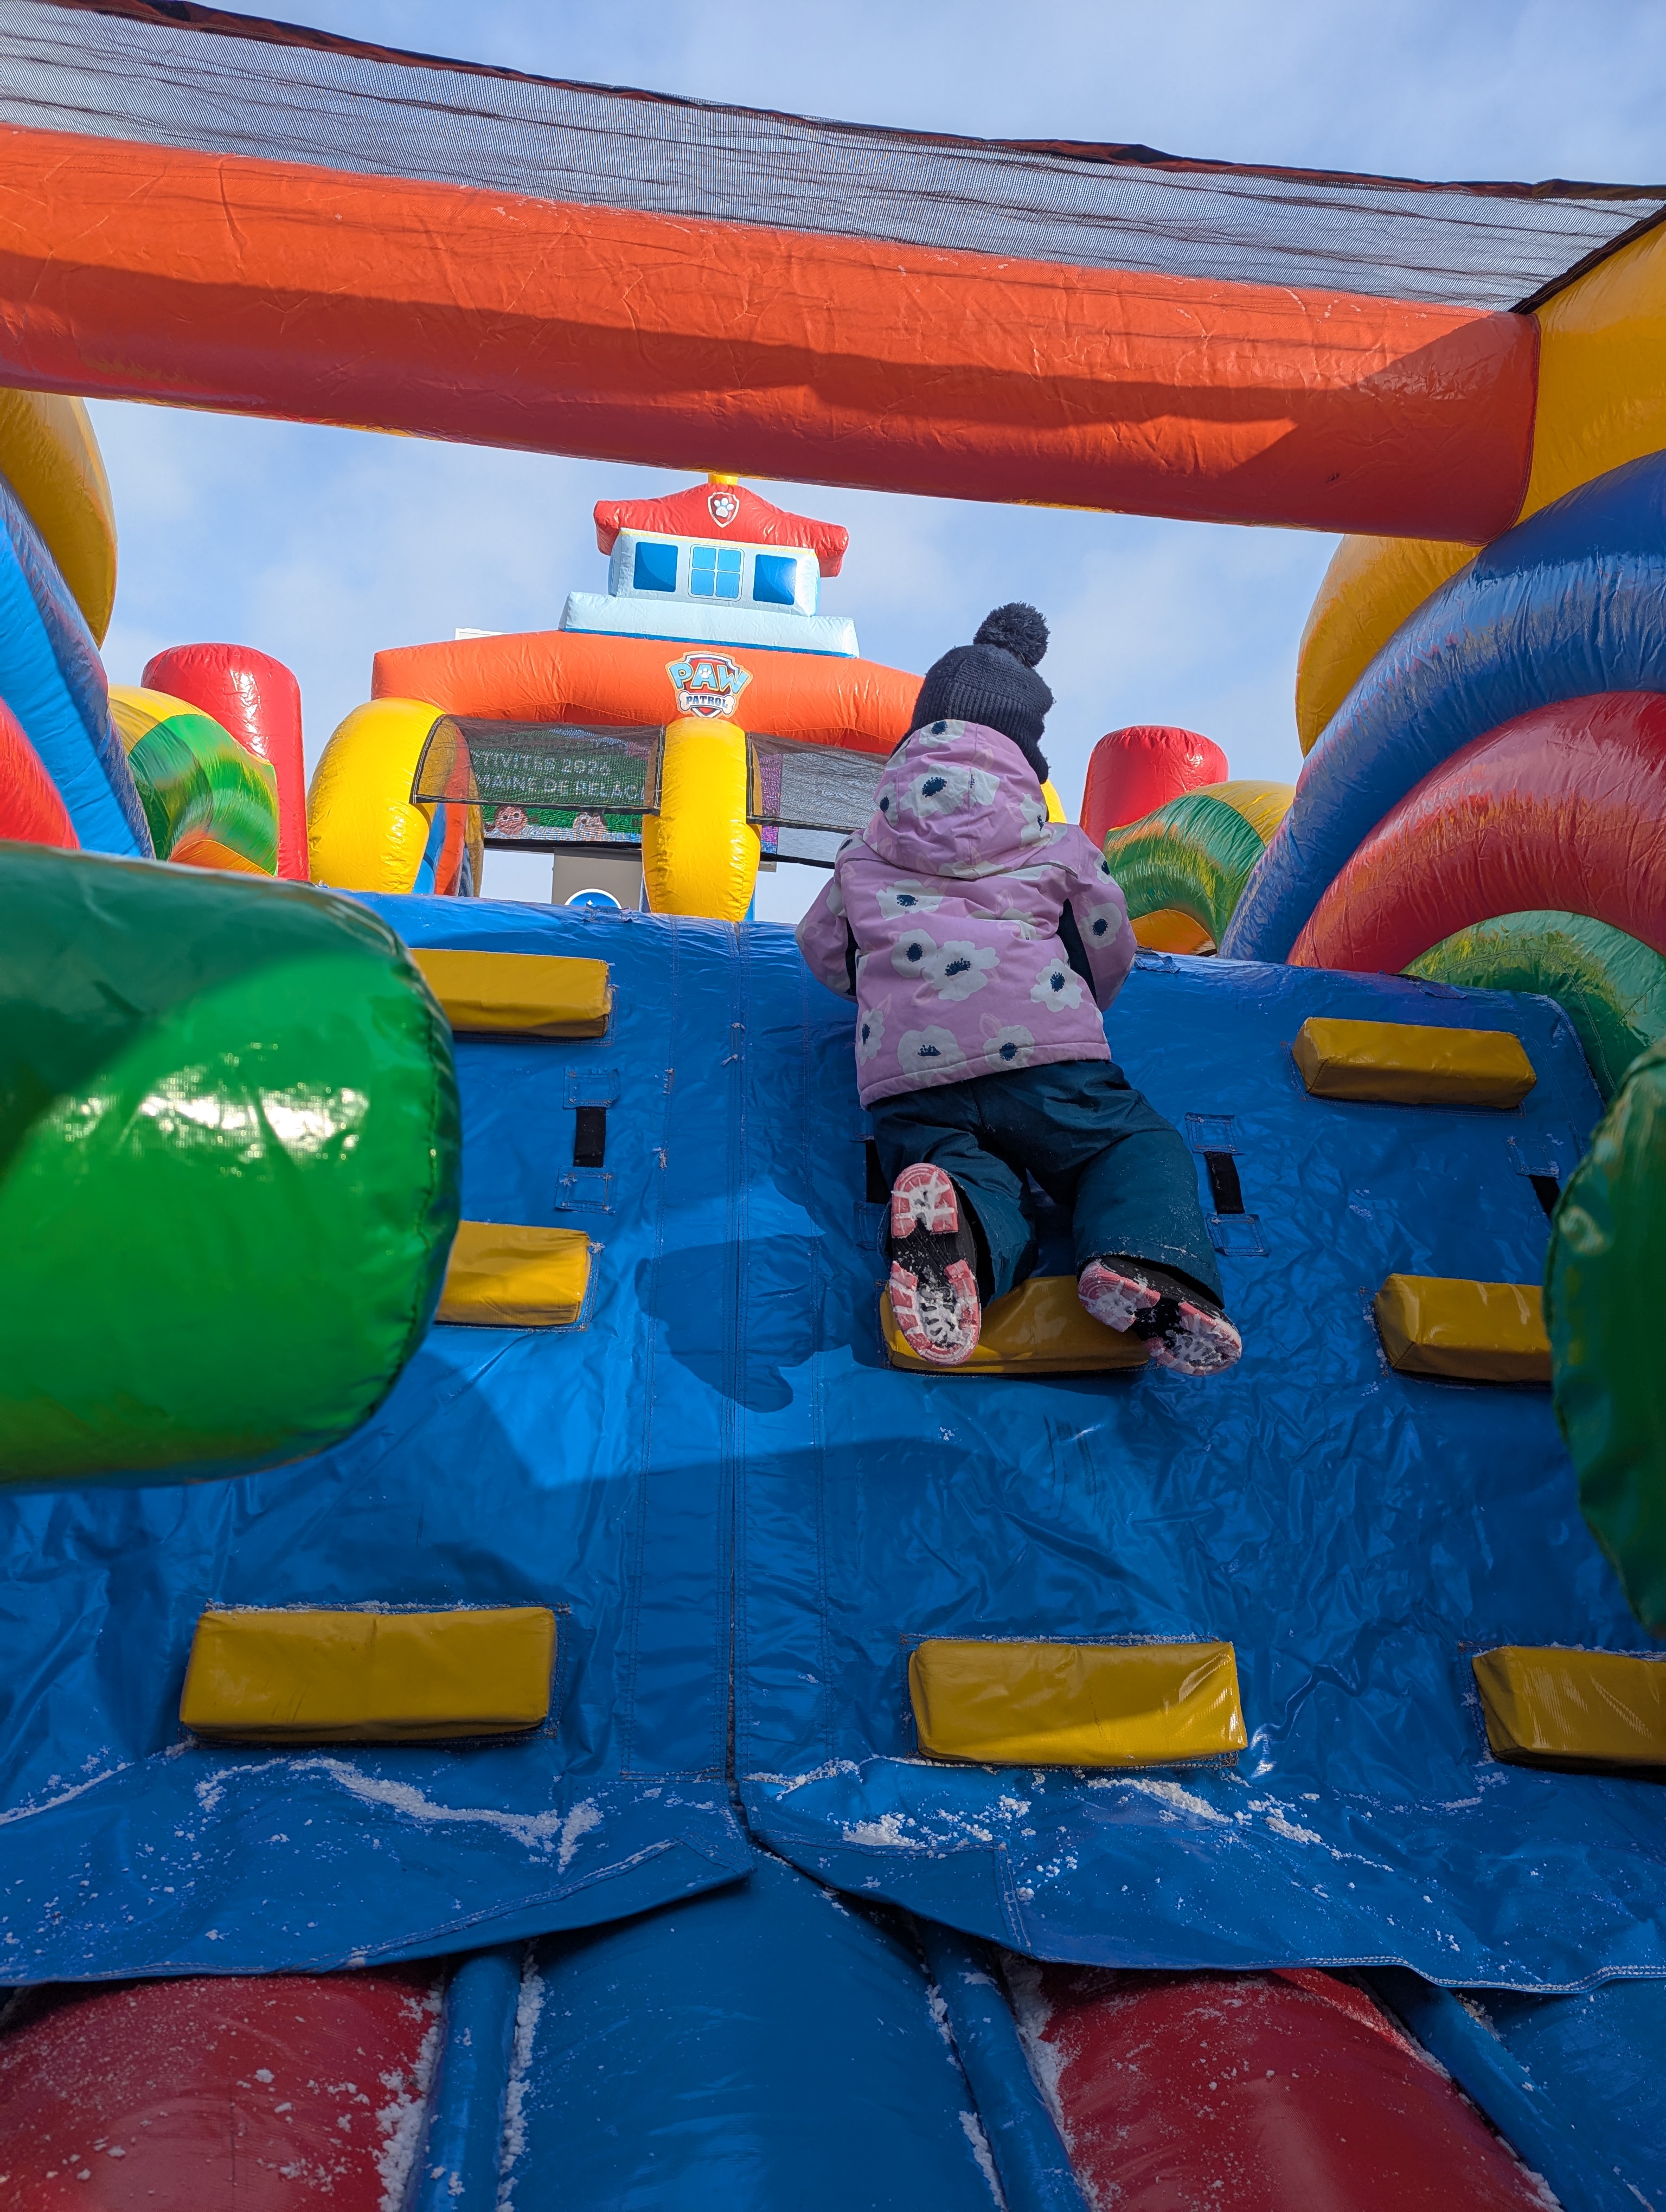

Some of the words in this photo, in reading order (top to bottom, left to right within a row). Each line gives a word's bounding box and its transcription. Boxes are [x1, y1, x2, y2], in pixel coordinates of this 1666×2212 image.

[669, 662, 749, 695] PAW
[685, 696, 728, 708] PATROL
[543, 777, 569, 794] DE
